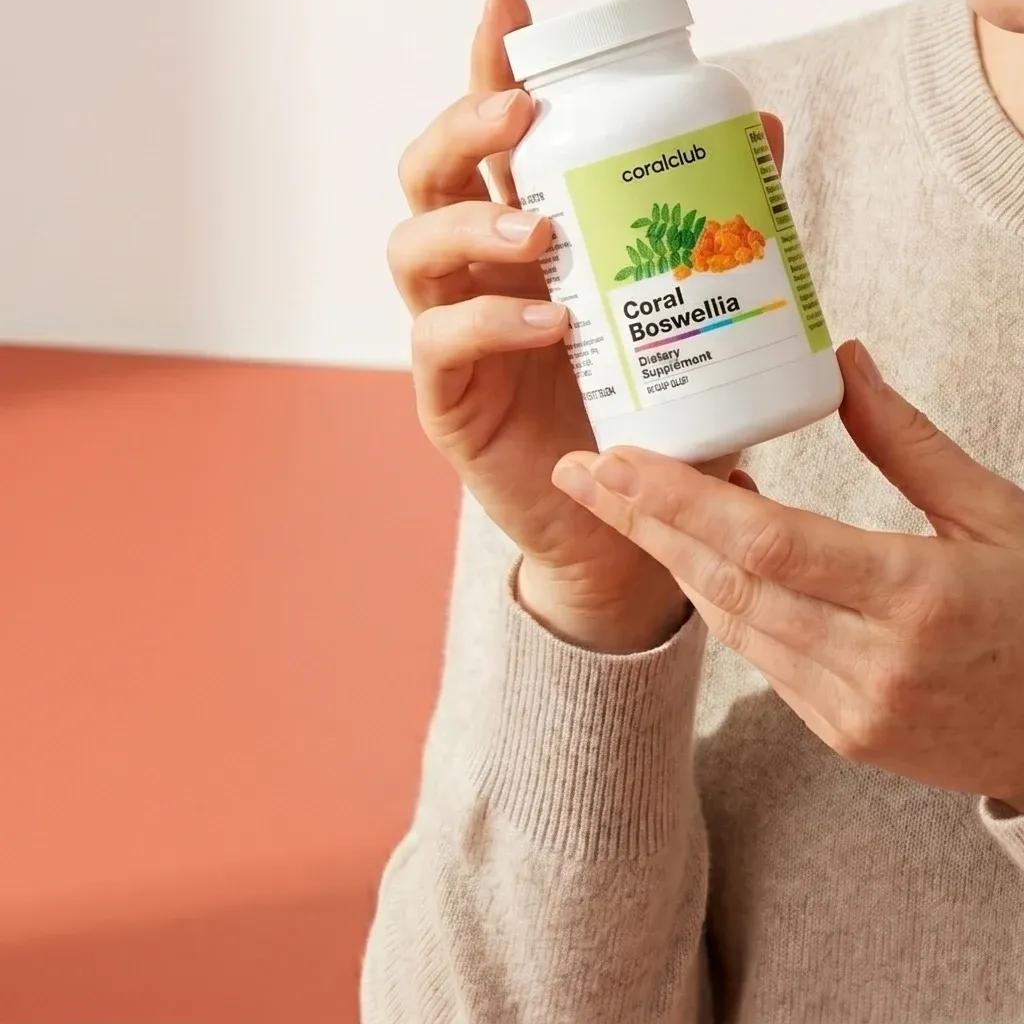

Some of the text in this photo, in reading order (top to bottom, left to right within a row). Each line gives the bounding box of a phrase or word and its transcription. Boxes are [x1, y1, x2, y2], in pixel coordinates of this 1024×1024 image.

[622, 144, 706, 182] coralclub
[623, 286, 684, 319] Coral
[628, 296, 740, 342] Boswellia
